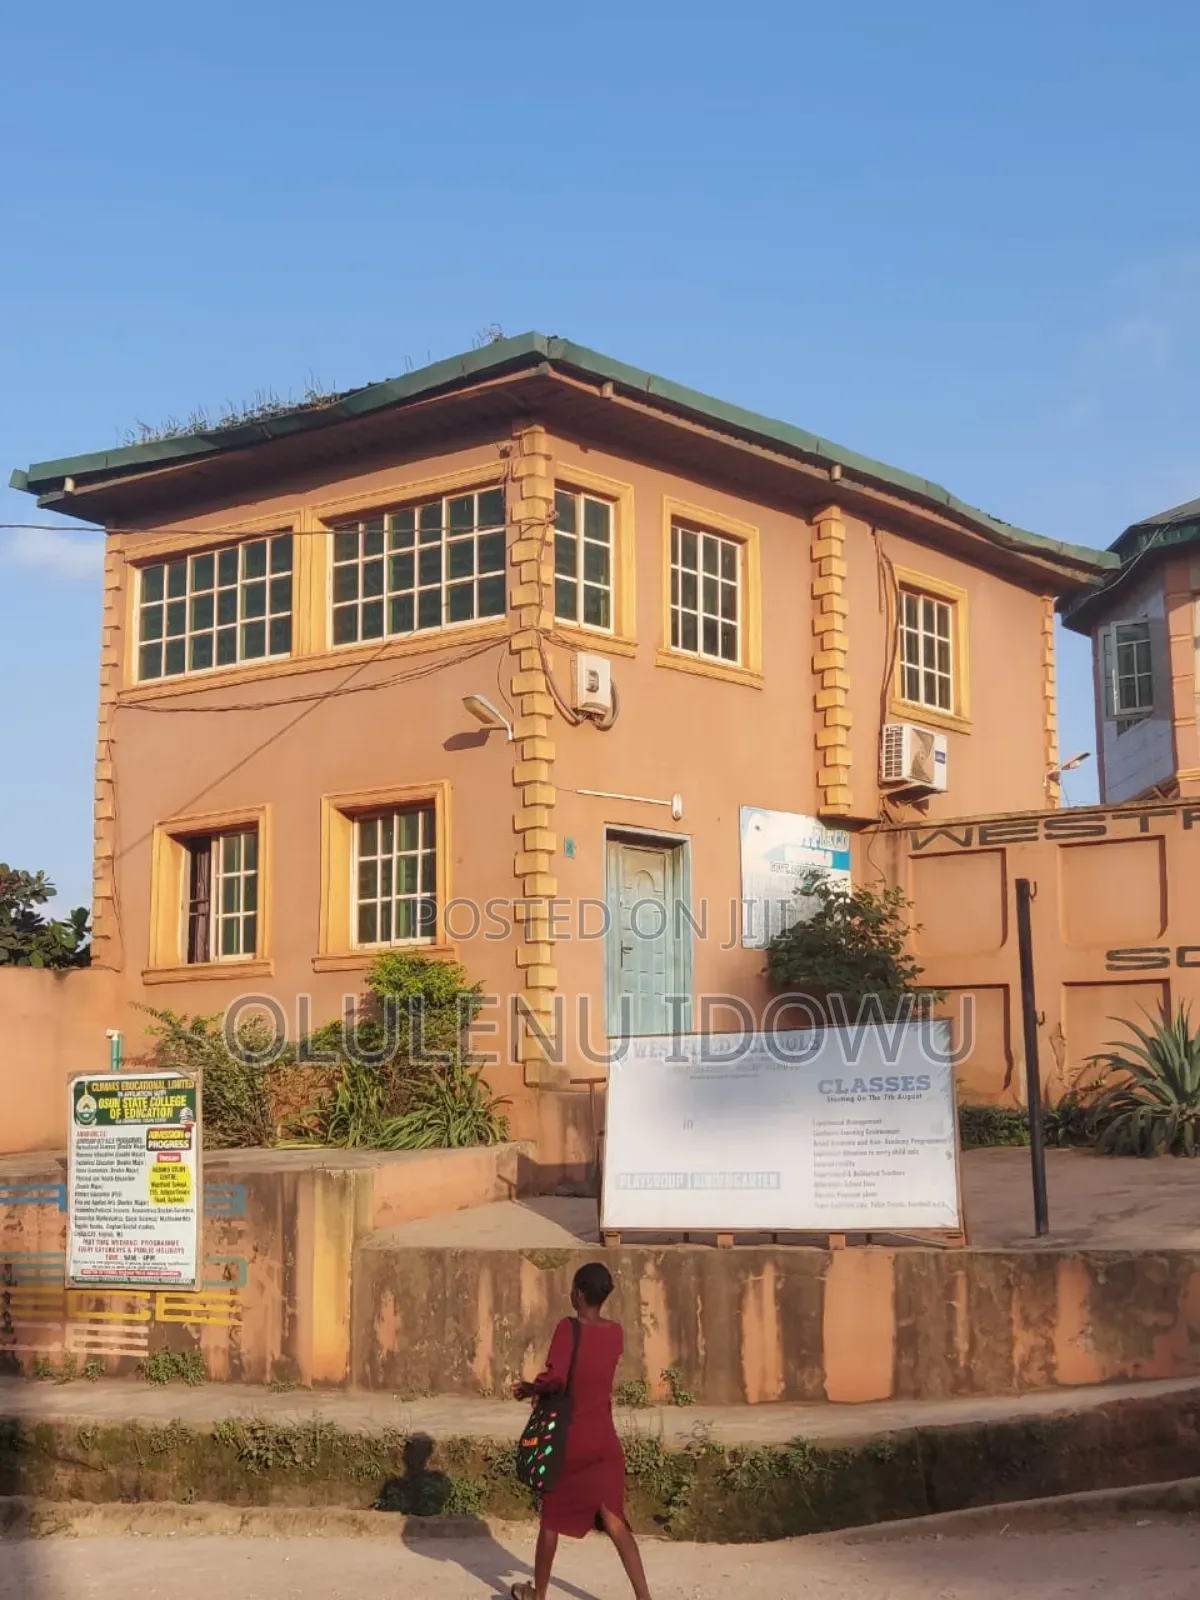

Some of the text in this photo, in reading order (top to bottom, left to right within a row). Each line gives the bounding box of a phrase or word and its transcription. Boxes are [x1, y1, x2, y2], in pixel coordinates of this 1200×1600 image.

[121, 1080, 165, 1091] EDUCATIONAL
[818, 1075, 931, 1094] CLASSES
[98, 1095, 187, 1109] OSUN STATE COLLEGE
[897, 1093, 922, 1102] August
[109, 1106, 173, 1120] OF EDUCATION
